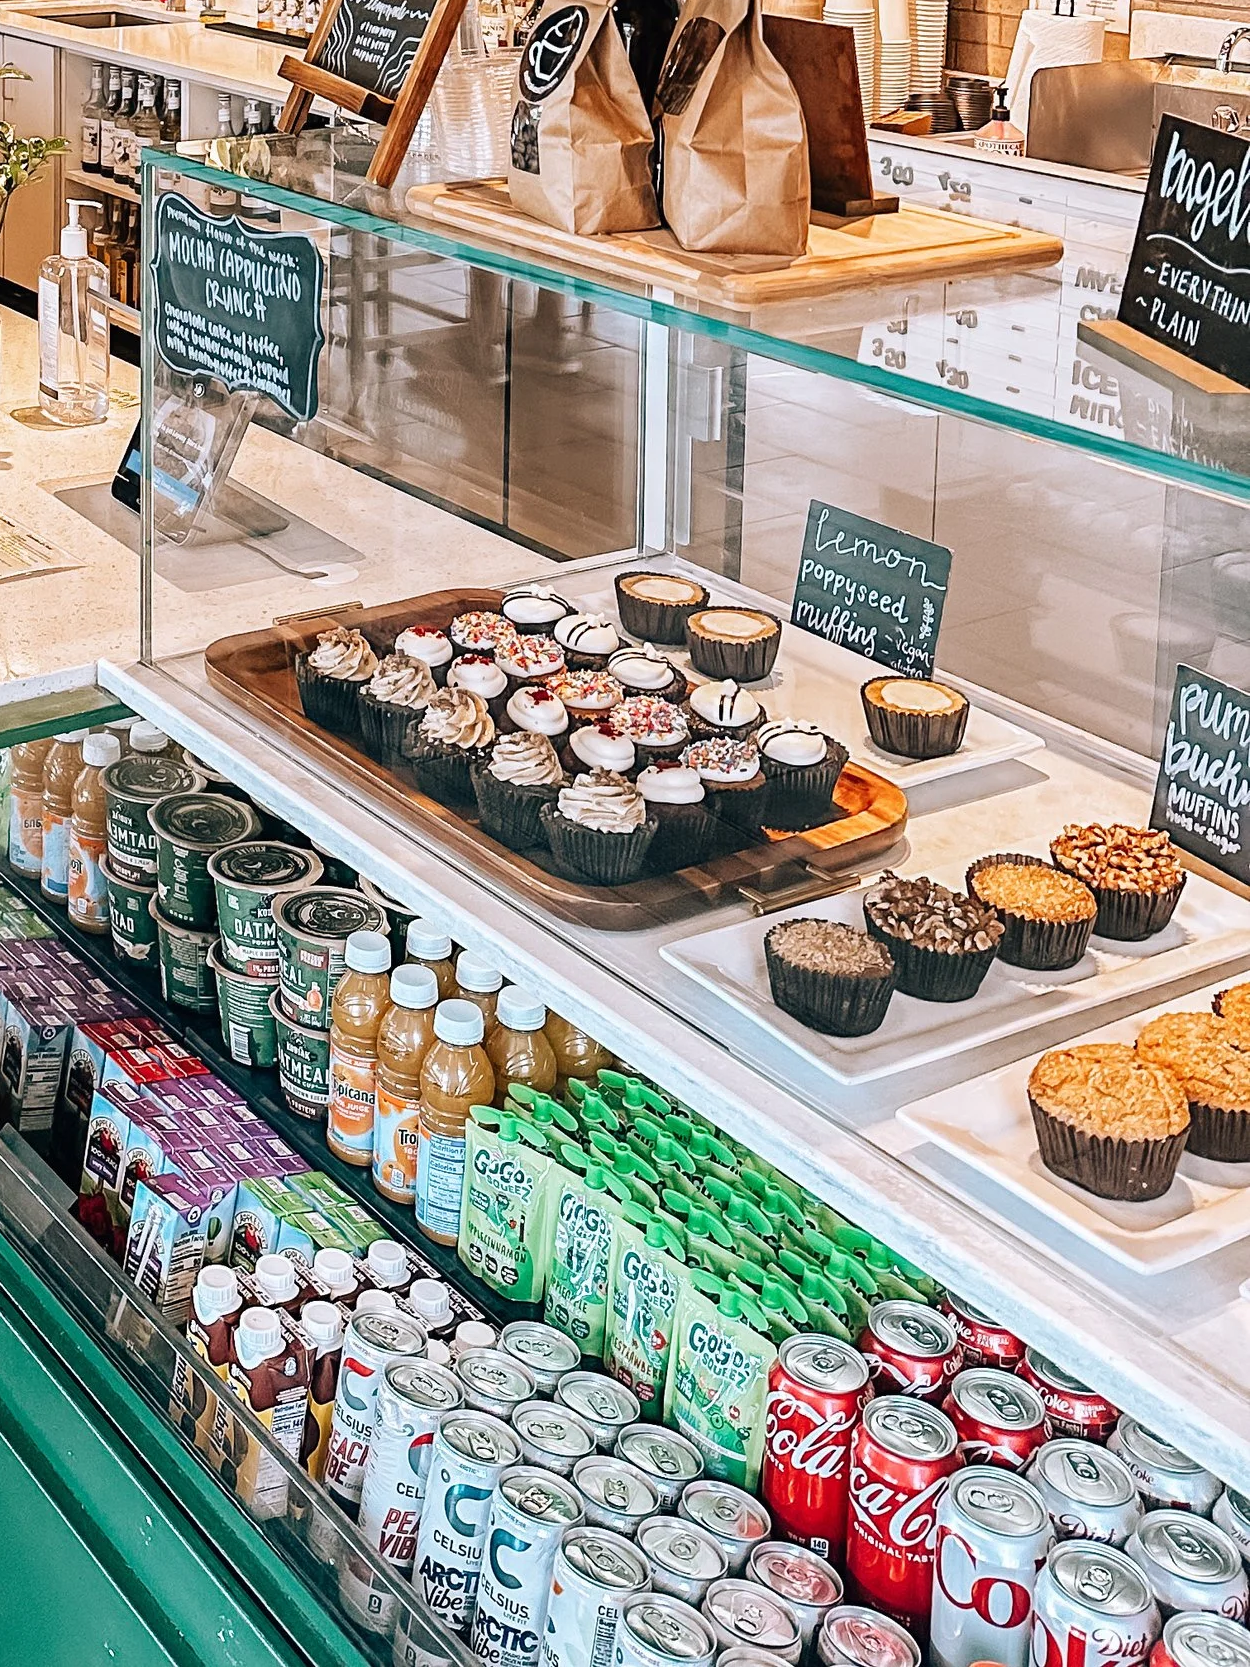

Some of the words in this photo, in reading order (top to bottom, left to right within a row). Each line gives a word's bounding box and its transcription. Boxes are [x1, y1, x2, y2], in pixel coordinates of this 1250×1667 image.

[1160, 131, 1250, 243] bagel
[169, 231, 216, 272] MOCHA
[219, 247, 302, 302] CAPPUCCINO
[205, 278, 267, 322] CRUNCH
[1150, 297, 1201, 347] PLAIN
[801, 558, 909, 624] poppyseed
[1167, 782, 1240, 840] MUFFINS
[278, 1046, 330, 1085] ATMEAL
[812, 1538, 827, 1550] 140
[853, 1521, 903, 1559] ORIGINAL
[1092, 1628, 1148, 1658] Diet
